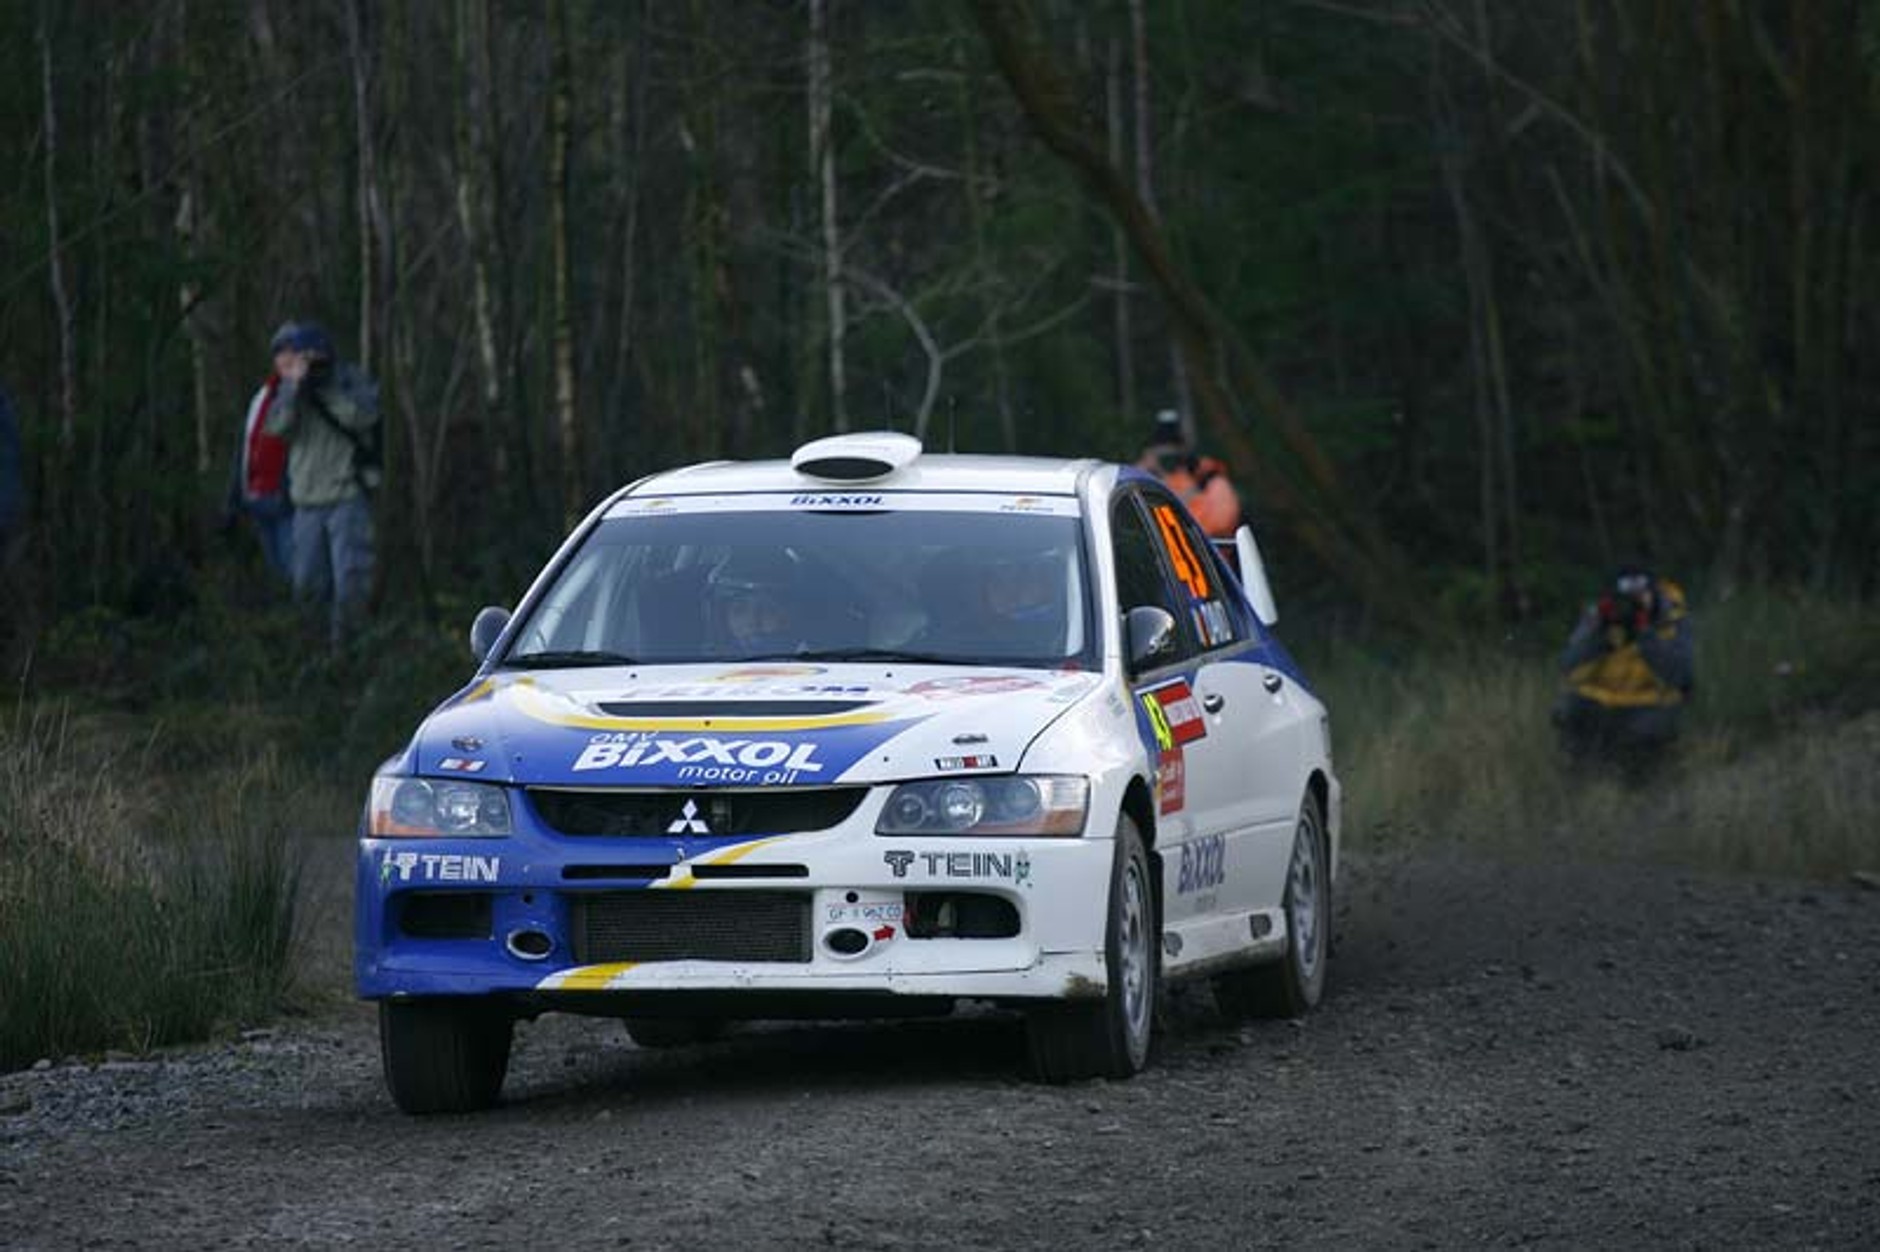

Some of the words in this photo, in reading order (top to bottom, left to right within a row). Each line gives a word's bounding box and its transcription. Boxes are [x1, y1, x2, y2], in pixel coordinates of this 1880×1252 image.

[590, 730, 659, 743] OMV
[678, 765, 758, 782] motor
[763, 769, 799, 784] oil
[421, 854, 500, 882] TEIN
[919, 852, 1012, 878] TEIN
